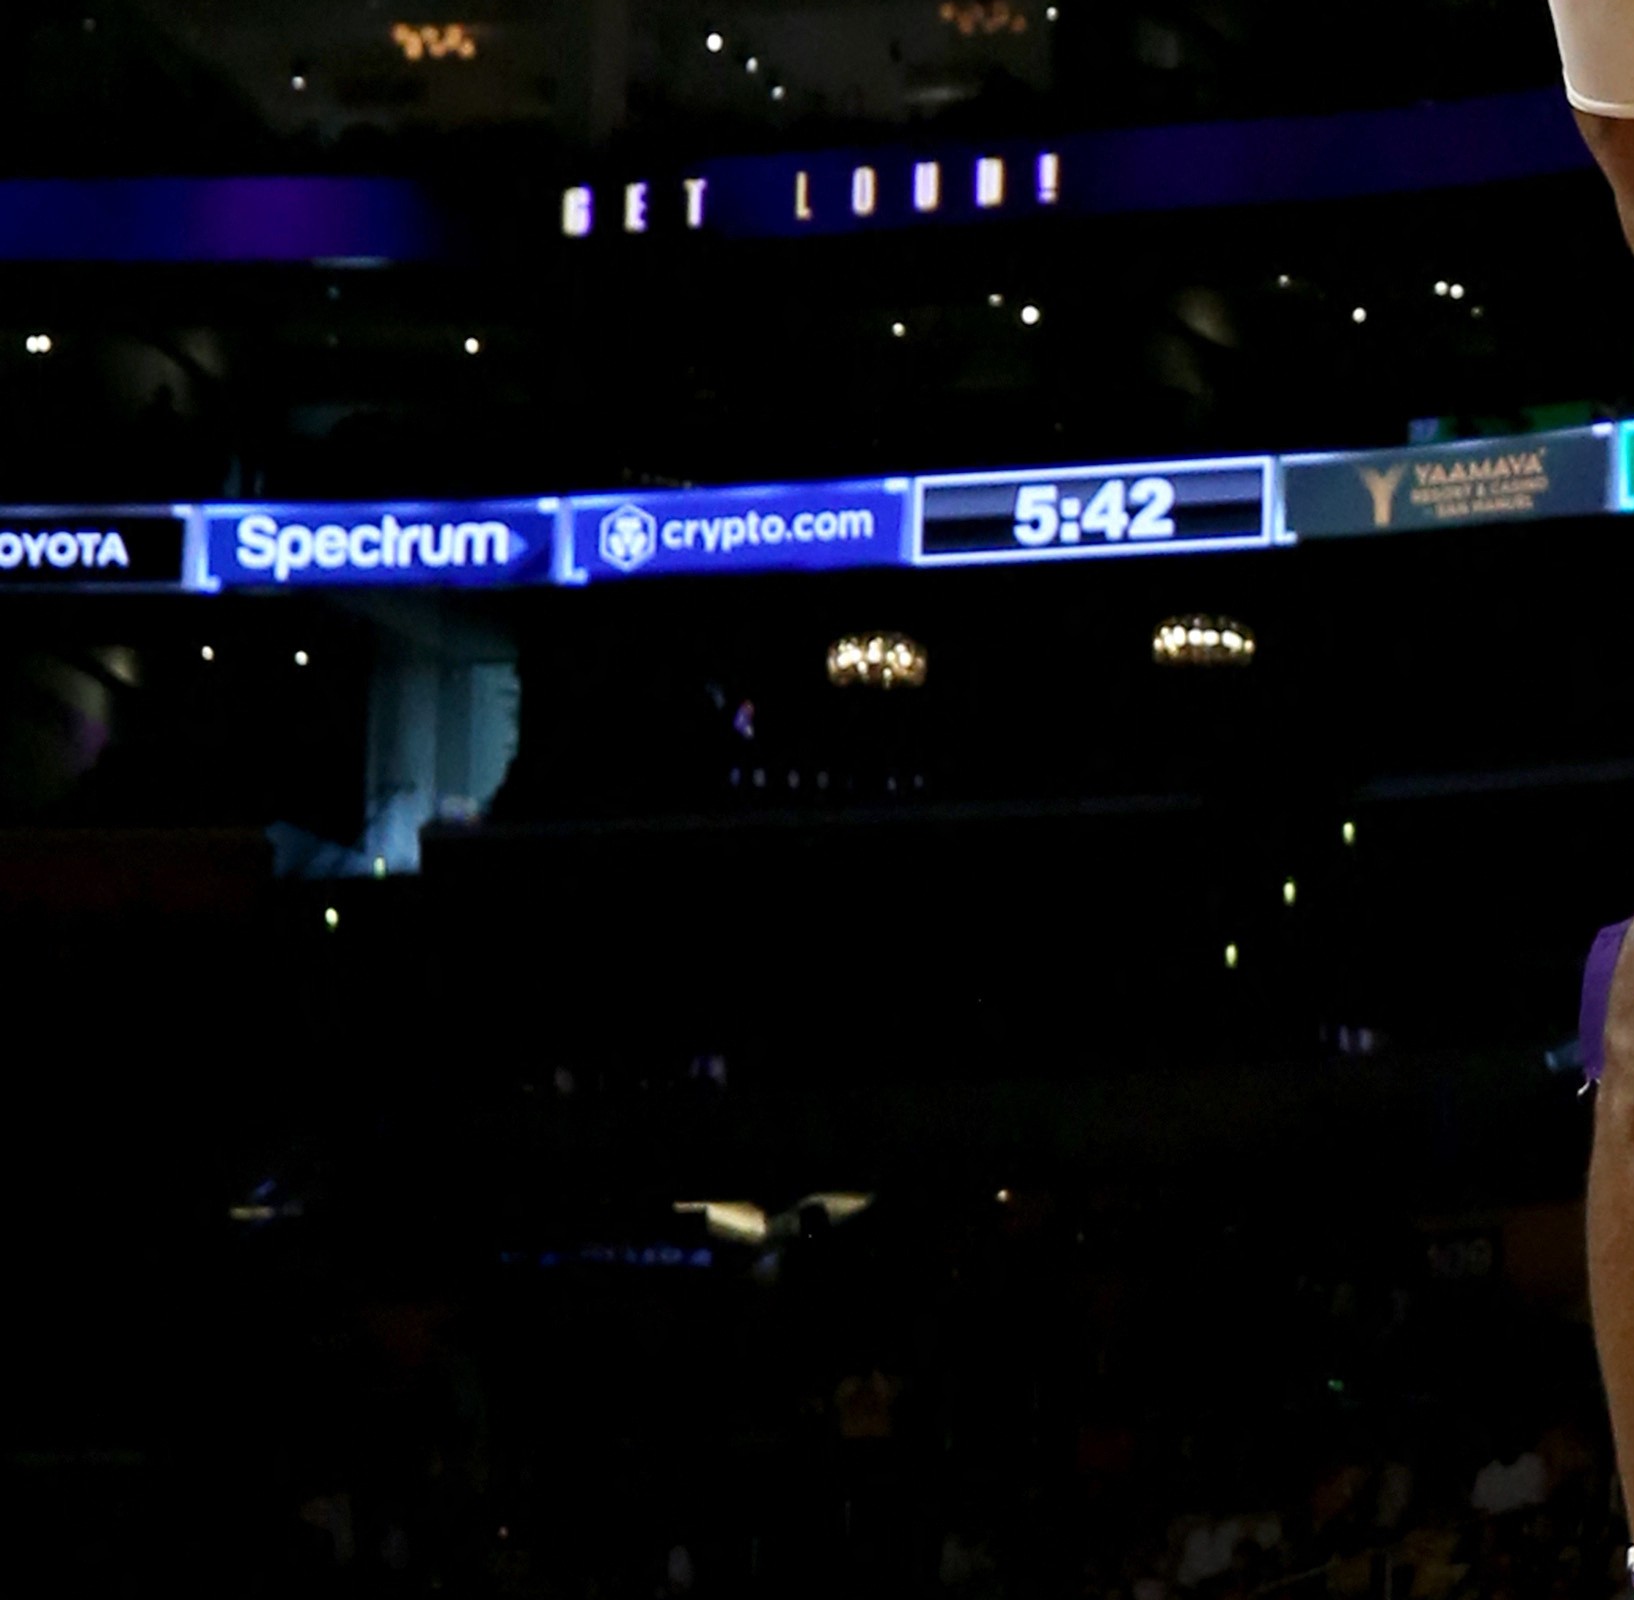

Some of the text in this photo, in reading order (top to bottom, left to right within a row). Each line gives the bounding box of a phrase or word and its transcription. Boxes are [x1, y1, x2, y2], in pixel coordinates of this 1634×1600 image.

[563, 178, 706, 237] GET
[662, 504, 875, 551] crypto.com
[1013, 477, 1175, 545] 5:42
[0, 531, 129, 568] OYOTA
[236, 514, 508, 581] Spectrum
